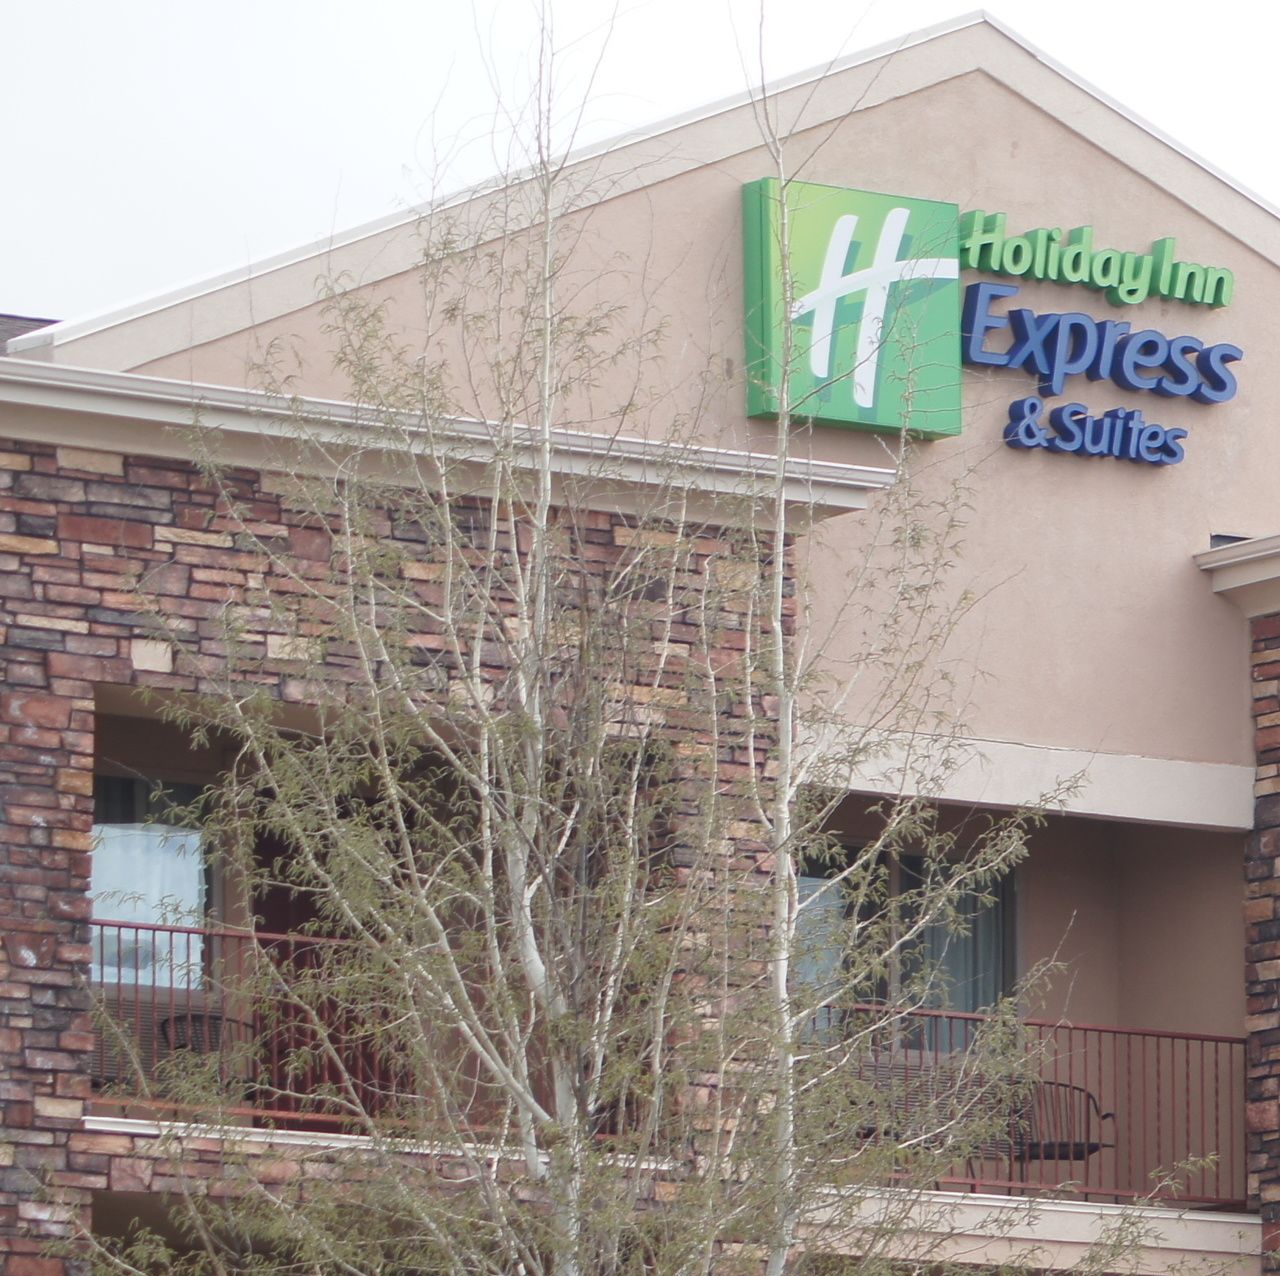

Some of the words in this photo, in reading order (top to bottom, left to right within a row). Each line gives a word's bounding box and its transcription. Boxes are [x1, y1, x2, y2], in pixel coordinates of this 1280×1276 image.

[961, 209, 1153, 305] Holiday
[1153, 236, 1234, 307] Inn
[963, 282, 1244, 404] Express
[1005, 396, 1049, 448] &
[1051, 402, 1188, 465] Suites
